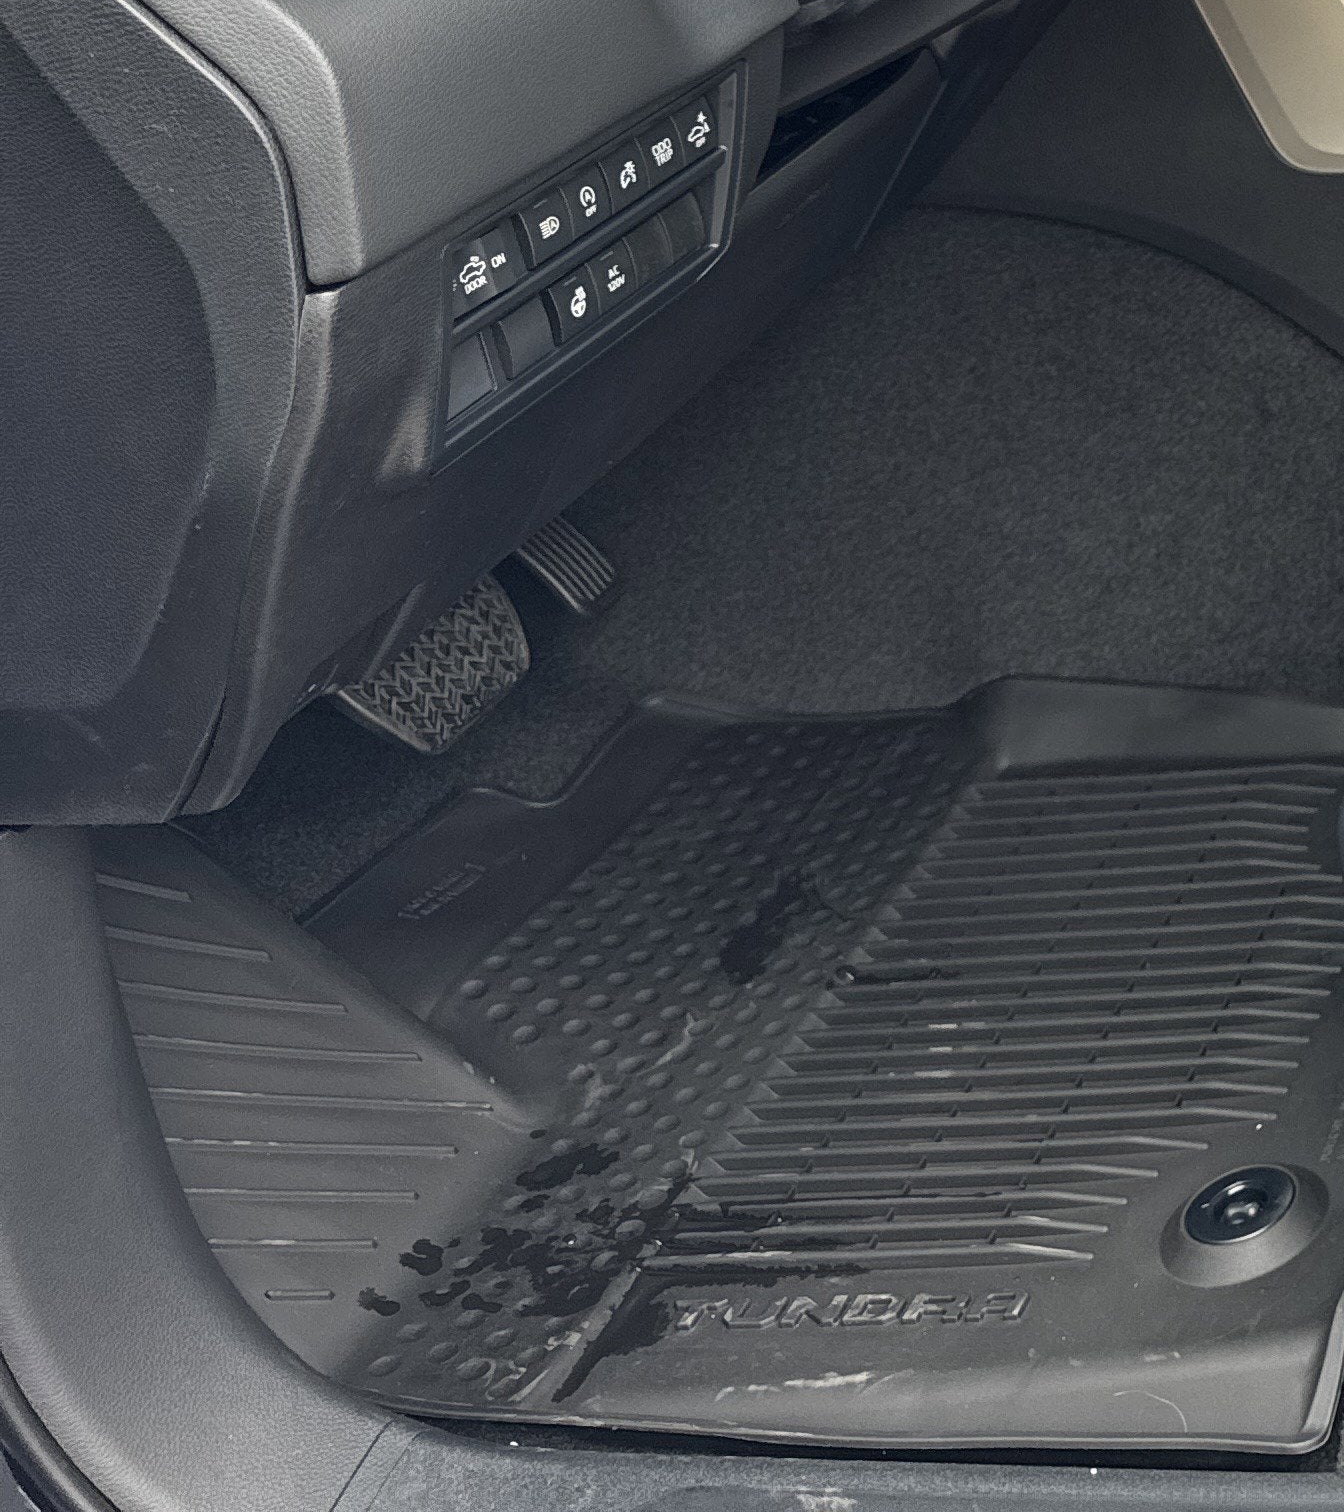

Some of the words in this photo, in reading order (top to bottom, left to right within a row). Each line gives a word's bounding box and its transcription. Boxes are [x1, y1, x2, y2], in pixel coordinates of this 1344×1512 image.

[651, 137, 672, 157] ODO
[653, 148, 674, 167] TRIP
[490, 252, 507, 269] ON
[607, 264, 622, 280] AC
[463, 275, 488, 295] DOOR
[607, 273, 626, 293] 120V
[671, 1289, 1033, 1333] TUNDRA
